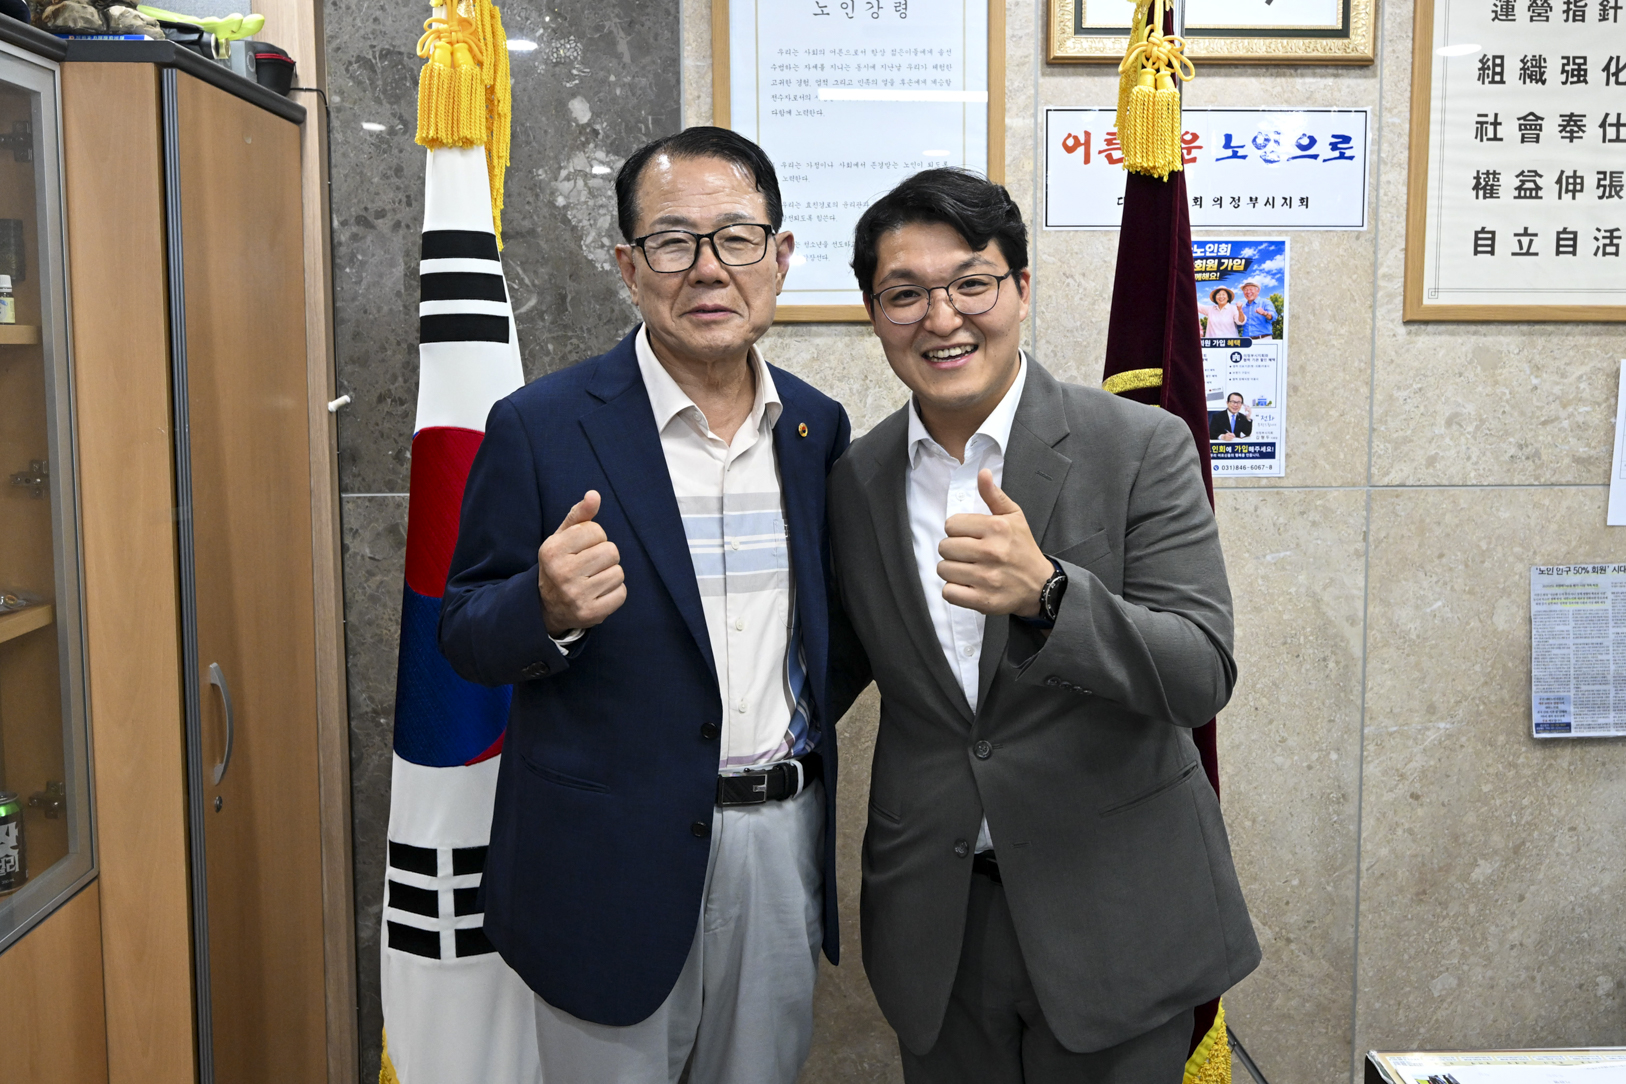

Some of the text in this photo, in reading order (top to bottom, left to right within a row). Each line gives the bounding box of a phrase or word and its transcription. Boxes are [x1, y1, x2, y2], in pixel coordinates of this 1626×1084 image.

[832, 79, 853, 87] 그리고
[1474, 112, 1626, 144] 社會奉仕
[781, 161, 801, 169] 우리는
[1212, 196, 1309, 209] 의정부시지회
[1473, 226, 1622, 258] 自立自活
[1220, 258, 1246, 271] 가입
[1556, 567, 1571, 575] 인구
[1573, 566, 1589, 574] 50%
